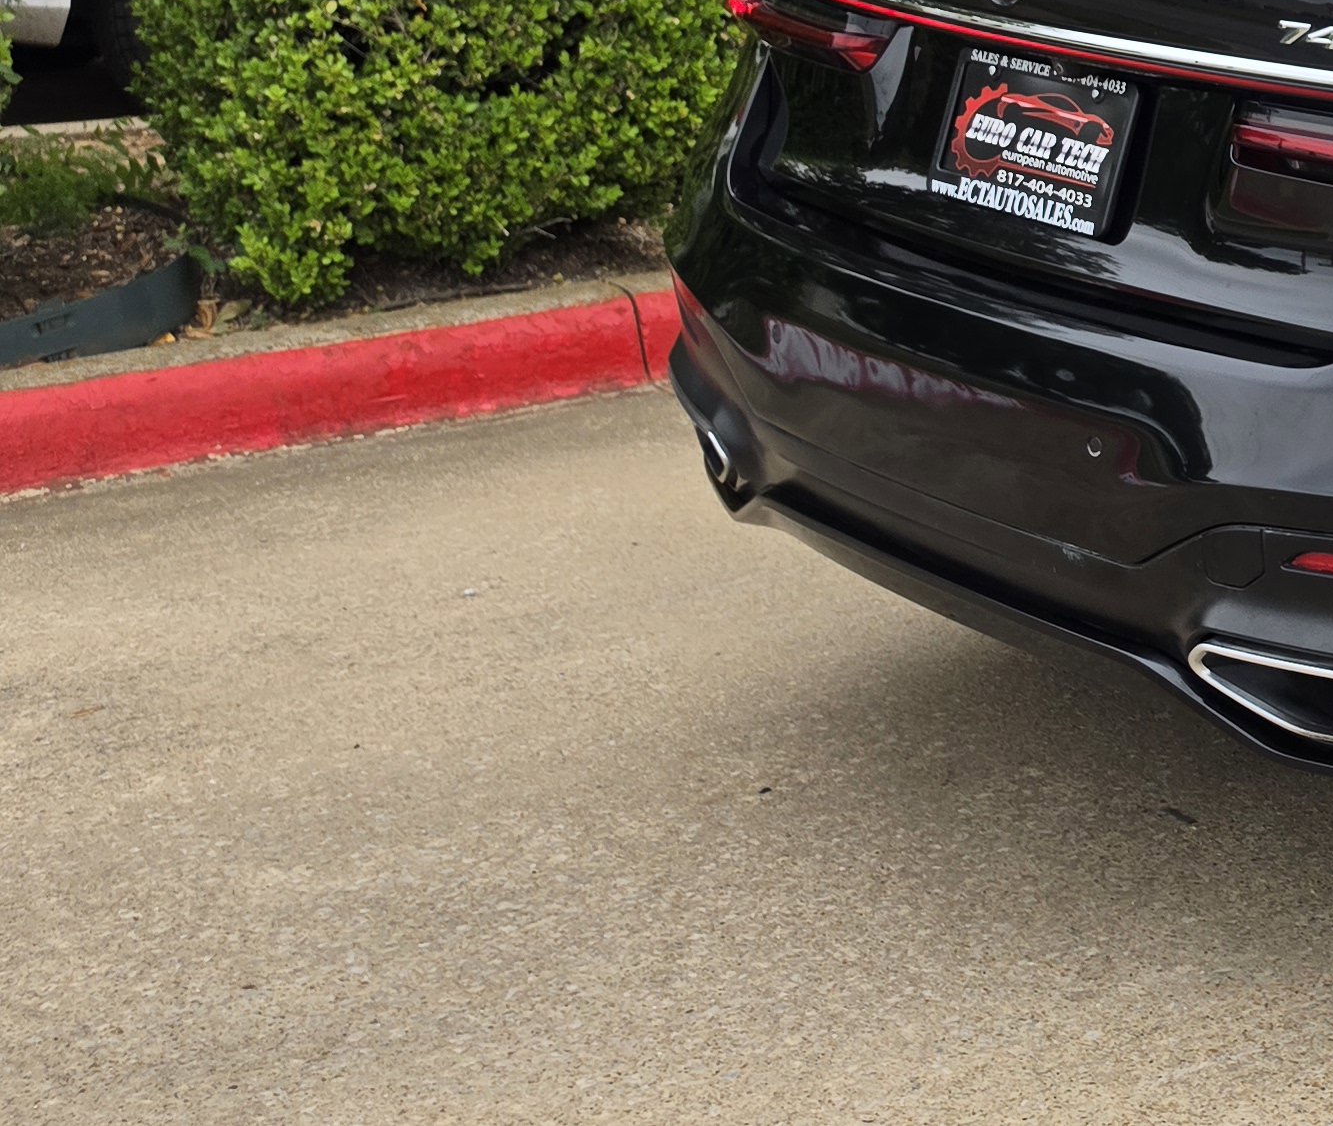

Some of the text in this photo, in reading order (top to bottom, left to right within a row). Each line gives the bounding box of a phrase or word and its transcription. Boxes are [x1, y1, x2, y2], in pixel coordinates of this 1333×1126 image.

[971, 48, 999, 66] SALES
[1000, 55, 1009, 68] &
[1010, 57, 1051, 77] SERVICE
[965, 113, 1109, 174] EURO CAR TECH
[1002, 149, 1099, 184] european automotive
[931, 176, 1095, 236] www.ECTAUTOSALES.com
[997, 169, 1093, 208] 817-404-4033
